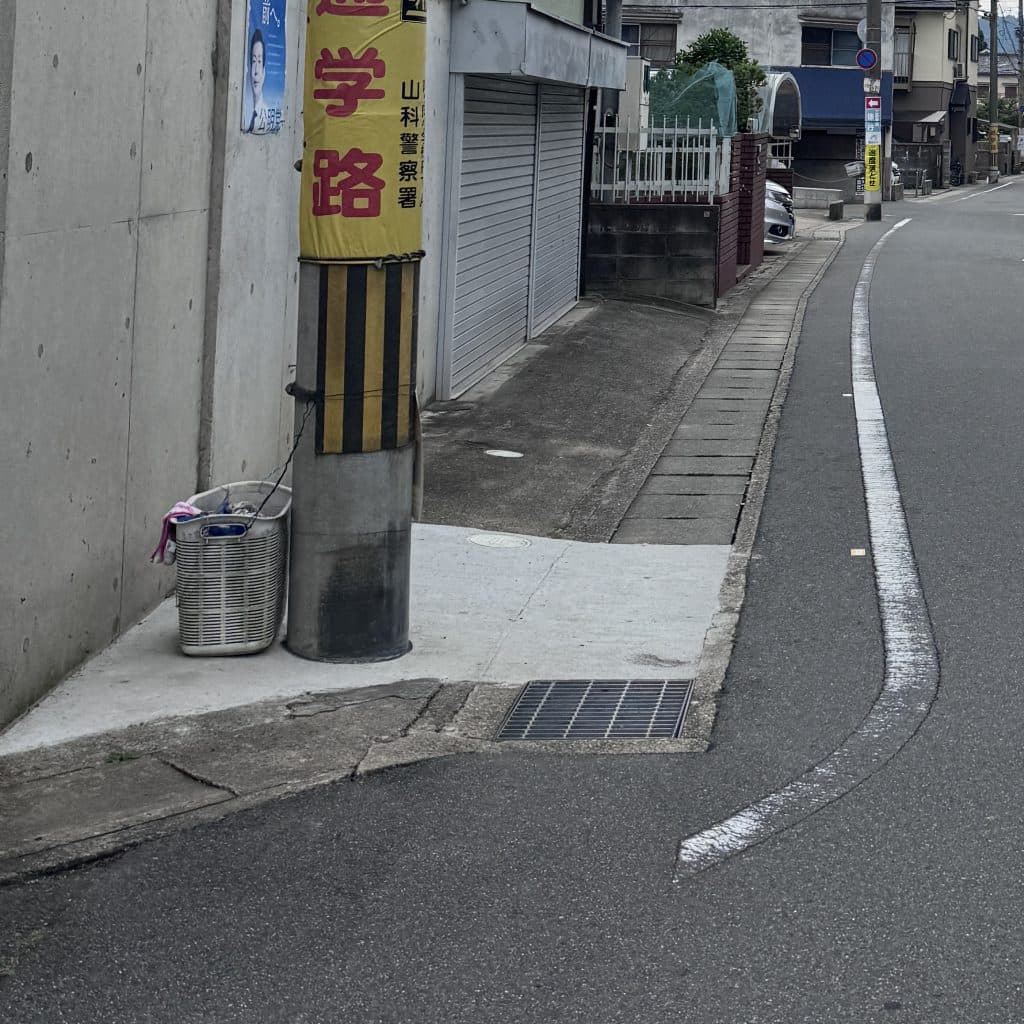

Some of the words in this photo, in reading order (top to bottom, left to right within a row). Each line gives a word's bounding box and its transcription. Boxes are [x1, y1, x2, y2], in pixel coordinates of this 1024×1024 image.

[398, 79, 420, 209] 山科警察署
